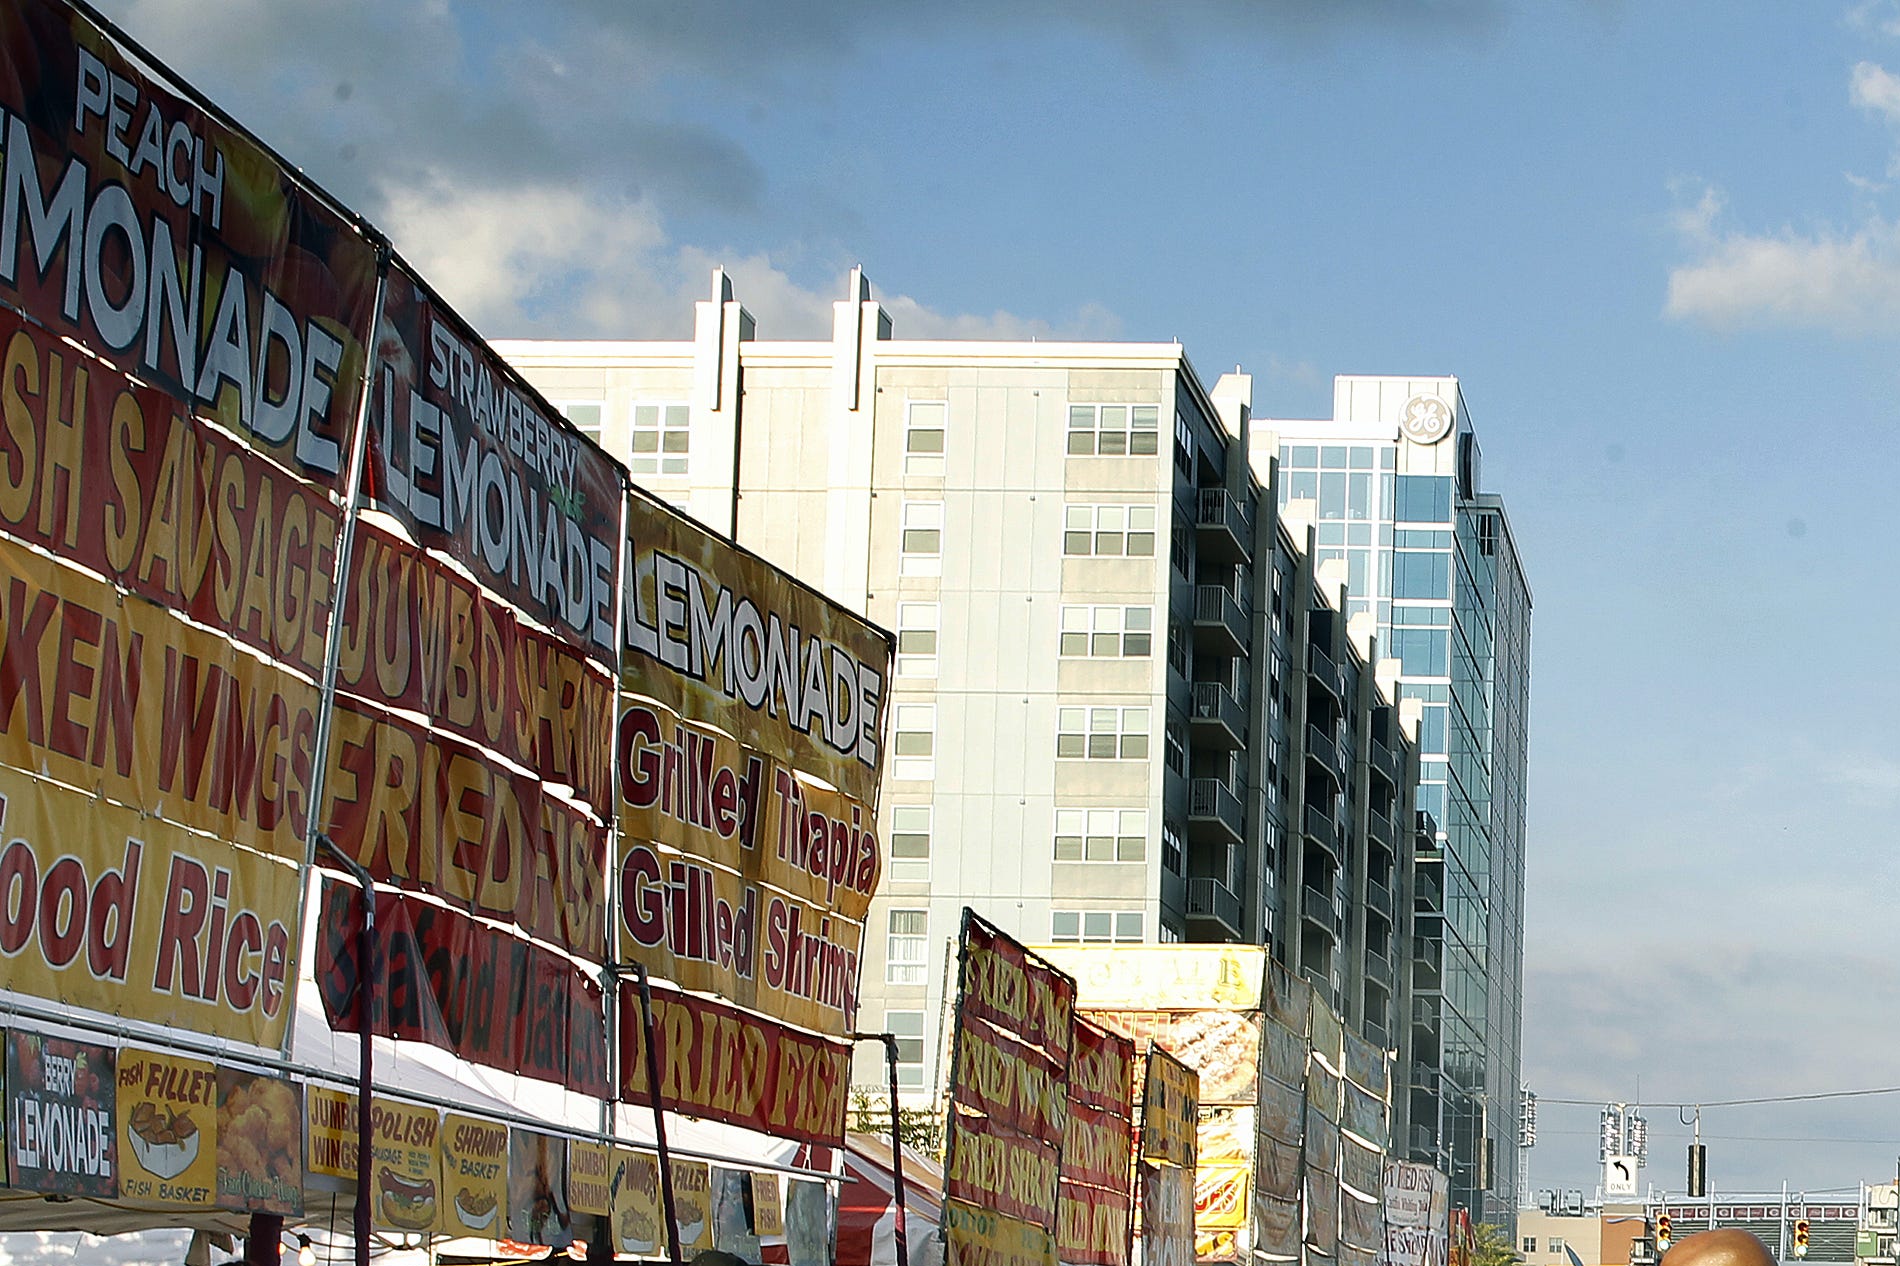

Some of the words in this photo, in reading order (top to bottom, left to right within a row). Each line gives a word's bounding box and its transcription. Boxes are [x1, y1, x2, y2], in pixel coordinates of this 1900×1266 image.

[75, 44, 225, 229] PEACH
[0, 108, 345, 476] MONADE
[429, 318, 579, 495] STRAWBERRY
[104, 390, 338, 672] SAUSAGE
[383, 364, 614, 653] LEMONADE
[341, 537, 506, 744] JUMBO
[623, 538, 881, 769] LEMONADE
[158, 645, 314, 842] WINGS
[619, 706, 763, 850] Grilled
[319, 704, 521, 915] FRIED
[0, 836, 145, 985] ood
[153, 851, 288, 1020] Rice
[620, 846, 757, 981] Gilled
[764, 896, 857, 1034] Shrimp
[45, 1053, 76, 1098] BERRY
[118, 1060, 144, 1088] FISH
[146, 1062, 216, 1107] FILLET
[631, 994, 768, 1118] FRIED
[770, 1034, 848, 1138] FISH
[15, 1097, 111, 1178] LEMONADE
[313, 1136, 359, 1172] WINGS
[370, 1104, 439, 1149] POLISH
[454, 1124, 508, 1159] SHRIMP
[460, 1158, 500, 1181] BASKET
[572, 1149, 607, 1178] JUMBO
[125, 1179, 152, 1197] FISH
[159, 1183, 209, 1202] BASKET
[571, 1180, 609, 1210] SHRIMP
[755, 1176, 777, 1203] FRIED
[759, 1208, 778, 1230] FISH
[1610, 1183, 1633, 1191] ONLY
